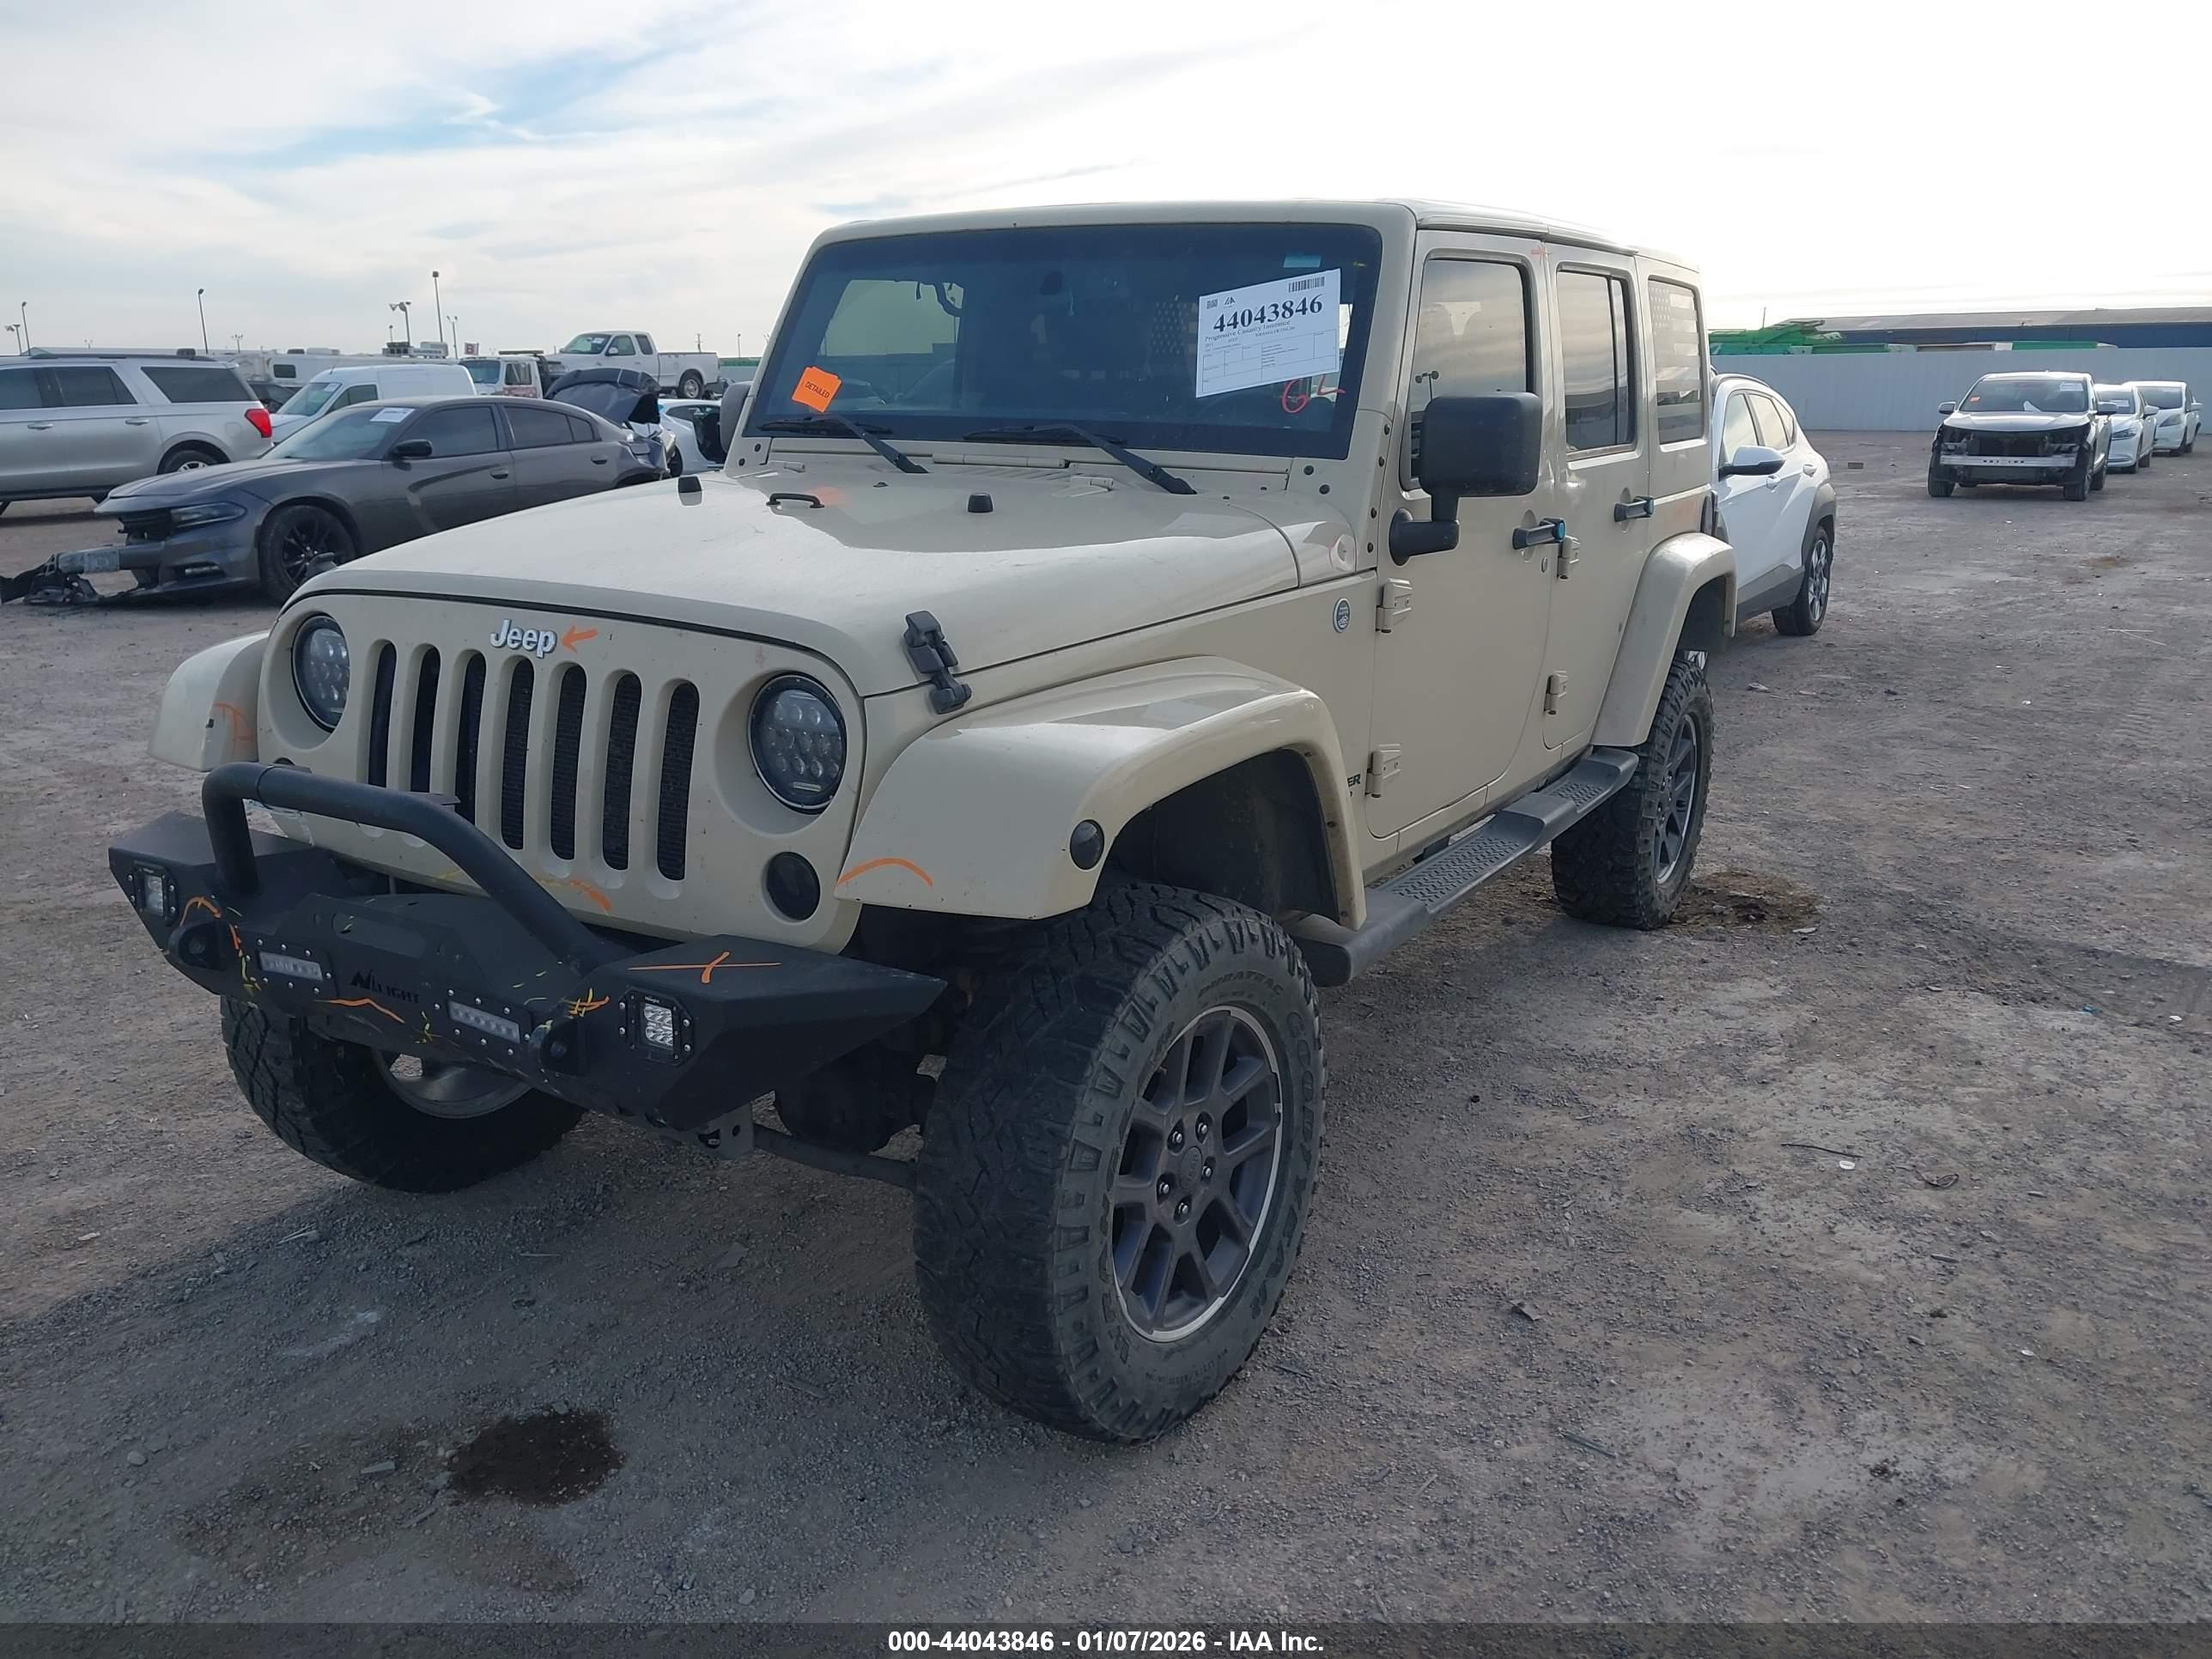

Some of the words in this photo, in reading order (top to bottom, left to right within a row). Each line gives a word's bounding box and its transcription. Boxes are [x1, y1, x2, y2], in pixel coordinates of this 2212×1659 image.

[1213, 294, 1324, 332] 44043846
[805, 380, 830, 398] DETAILED
[490, 618, 558, 659] Jeep
